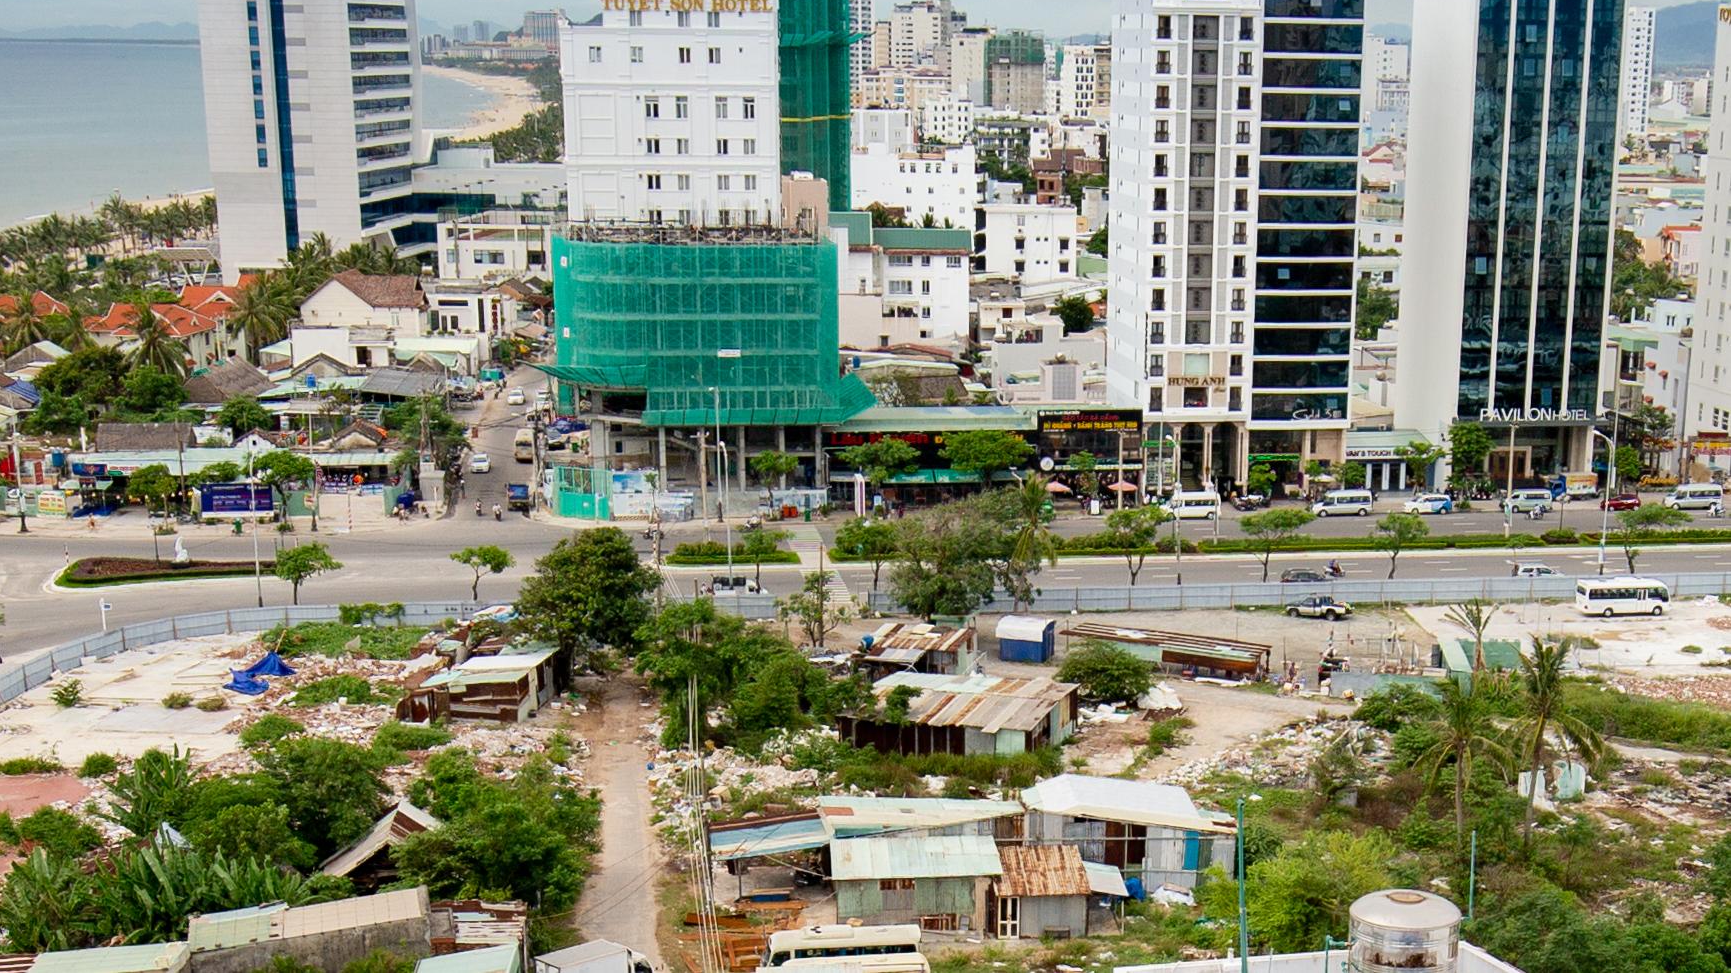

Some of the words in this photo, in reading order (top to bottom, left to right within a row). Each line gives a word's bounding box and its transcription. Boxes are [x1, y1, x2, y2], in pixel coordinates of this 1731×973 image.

[1202, 377, 1226, 386] ANH
[1480, 408, 1551, 422] PAVILION
[1552, 409, 1590, 422] HOTEL
